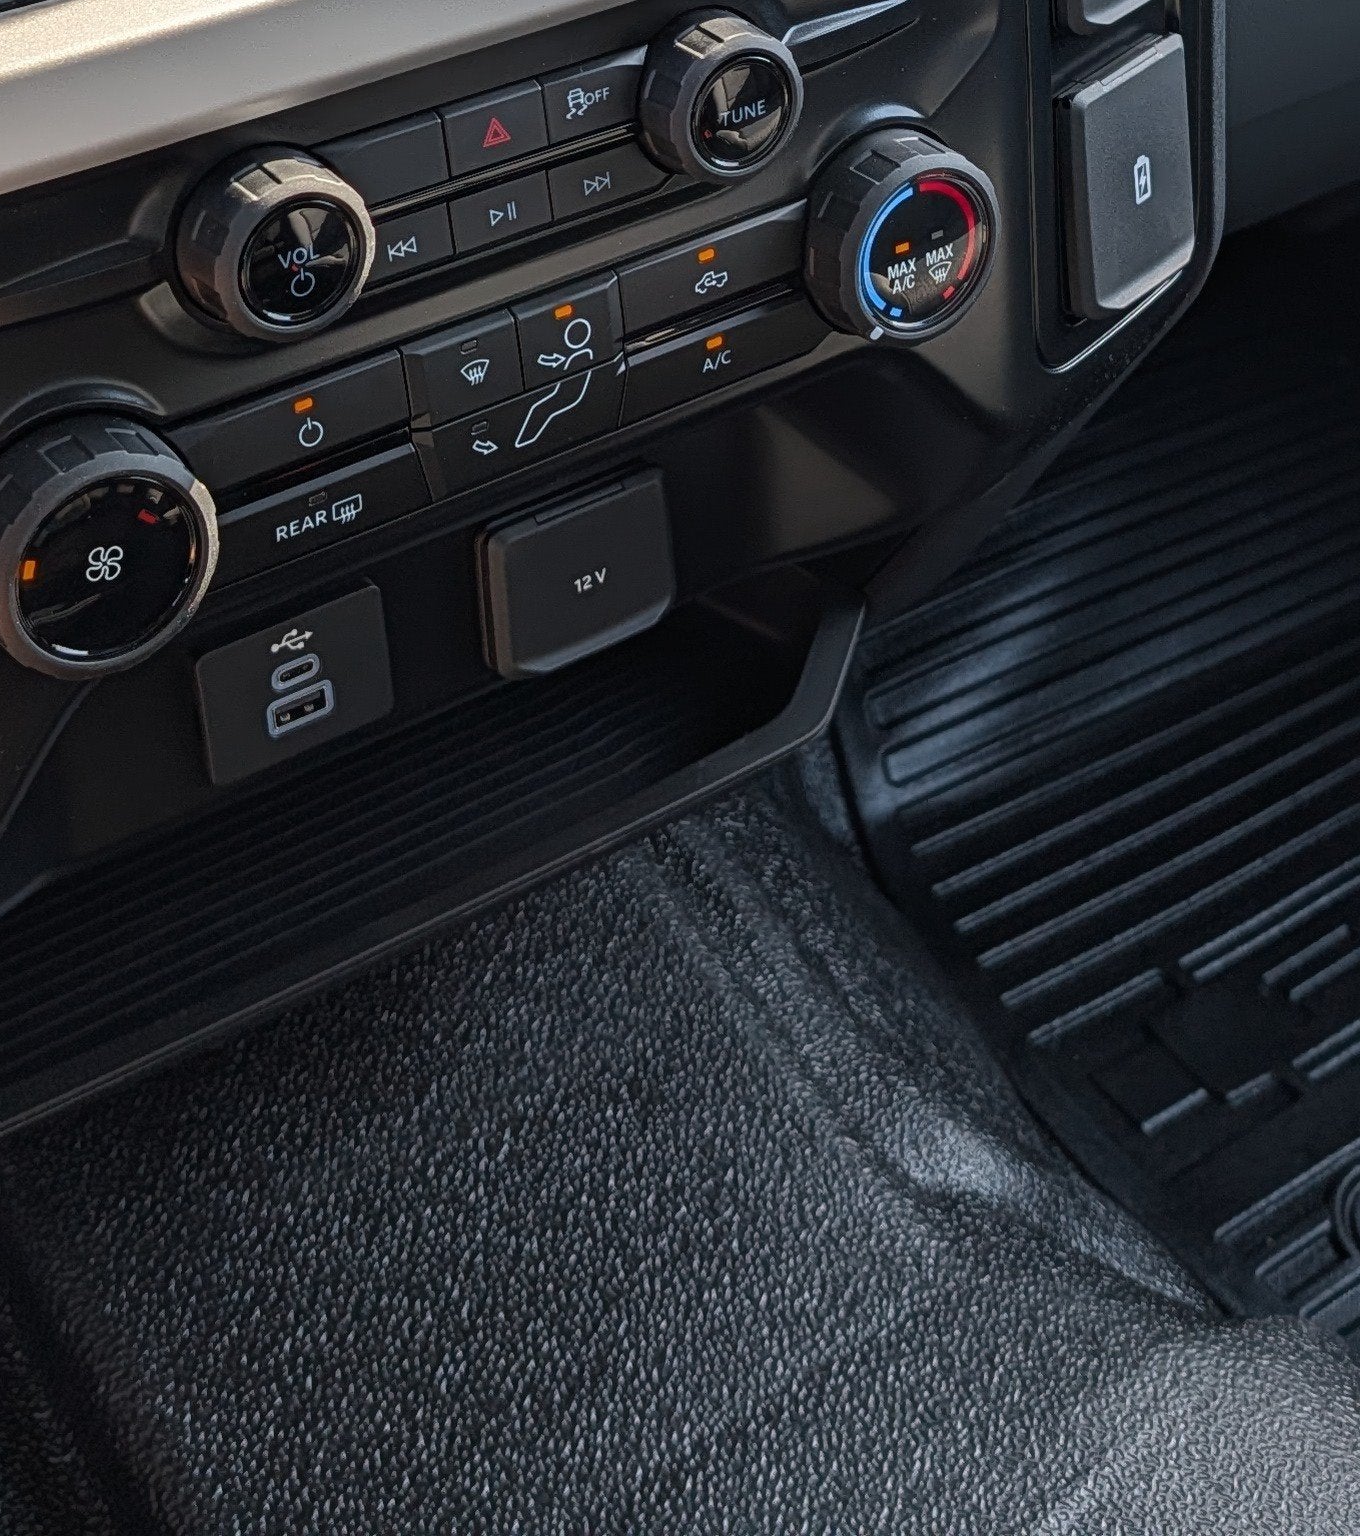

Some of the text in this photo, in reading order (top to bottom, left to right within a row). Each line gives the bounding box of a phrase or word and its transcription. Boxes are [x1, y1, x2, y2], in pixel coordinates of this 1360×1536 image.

[584, 87, 610, 105] OFF
[719, 98, 766, 126] TUNE
[277, 244, 320, 269] VOL
[925, 243, 954, 266] MAX
[887, 257, 916, 280] MAX
[892, 274, 915, 295] A/C
[702, 350, 732, 373] A/C
[276, 510, 327, 542] REAR
